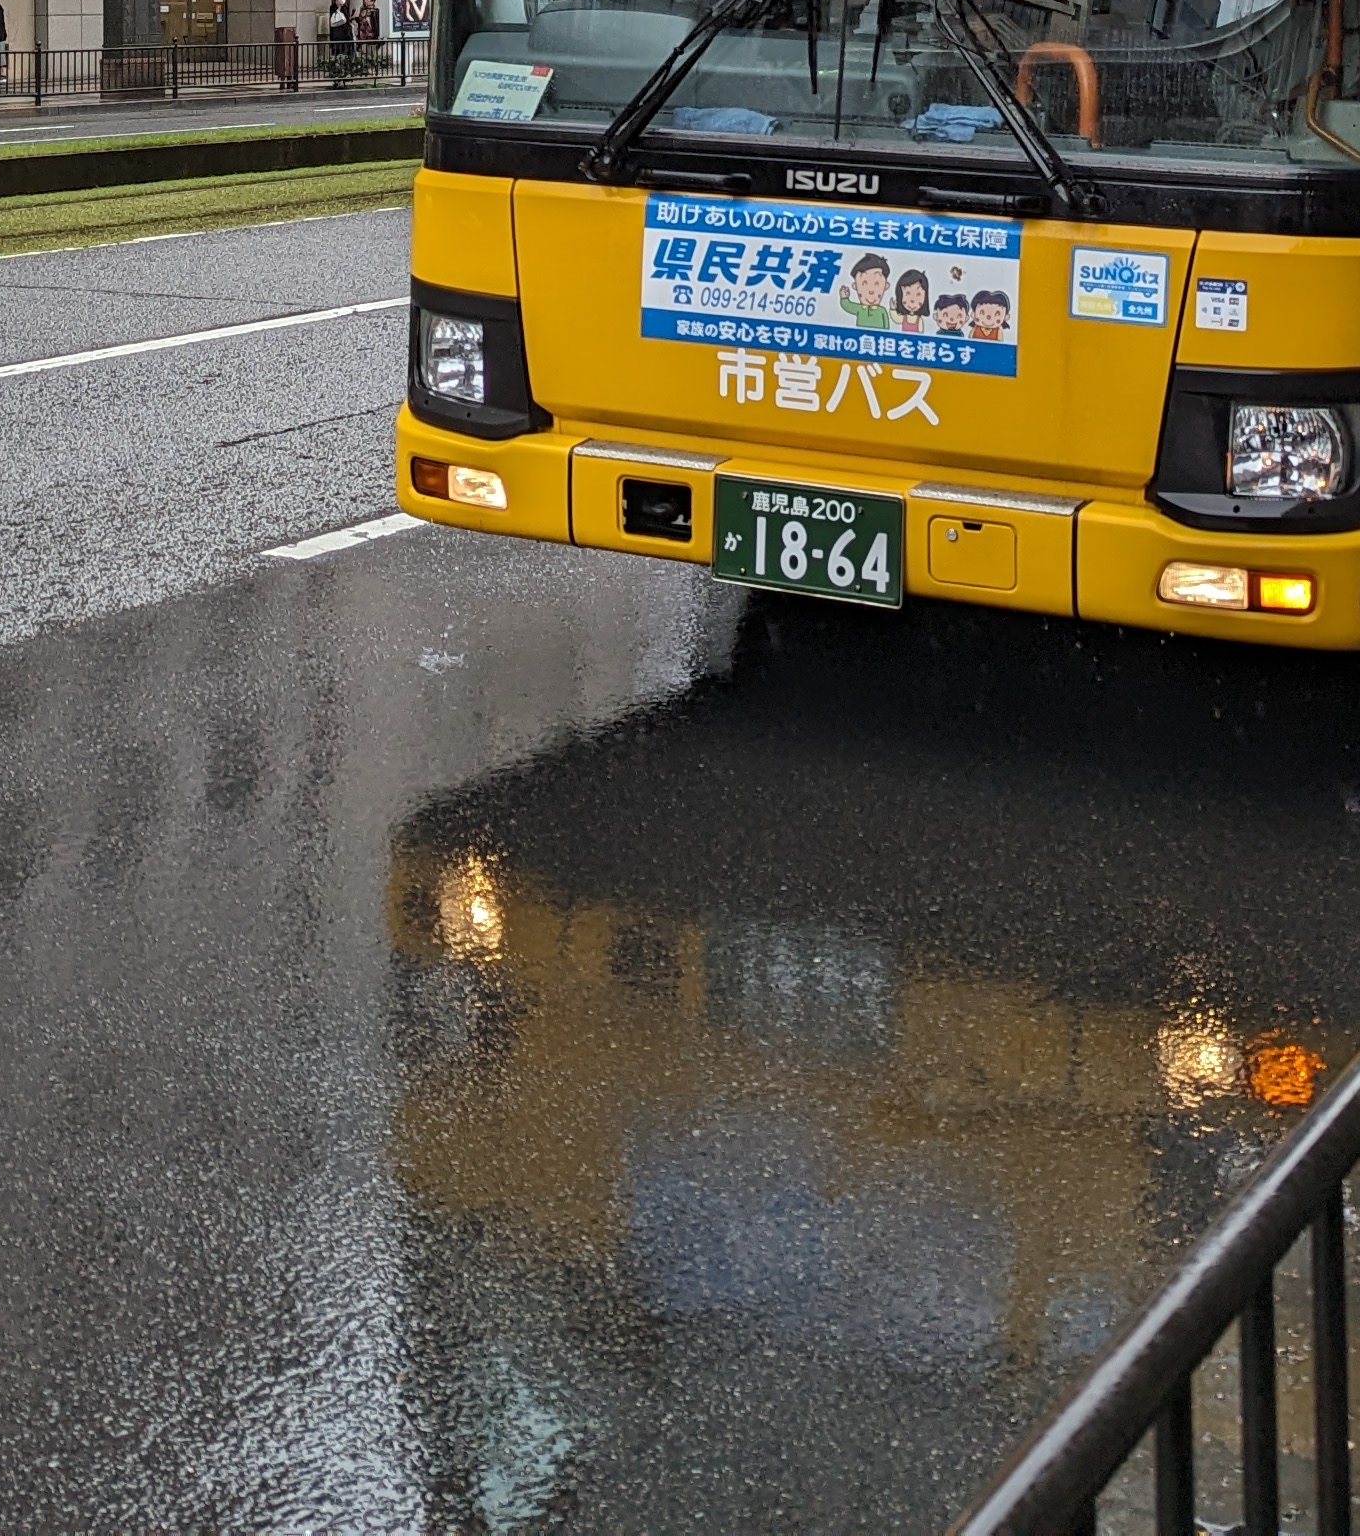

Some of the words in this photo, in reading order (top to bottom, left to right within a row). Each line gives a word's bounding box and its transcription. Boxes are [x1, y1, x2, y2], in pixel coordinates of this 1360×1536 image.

[785, 169, 880, 196] ISUZU
[656, 202, 1009, 252] 助けあいの心から生まれた保障
[650, 236, 843, 295] 県民共済
[700, 286, 817, 317] 099-214-5666
[676, 320, 809, 347] 家族の安心を守り
[813, 332, 976, 365] 家計の負担を減らす
[717, 346, 941, 427] 市営バス
[724, 532, 743, 552] か
[755, 516, 890, 594] 18-64
